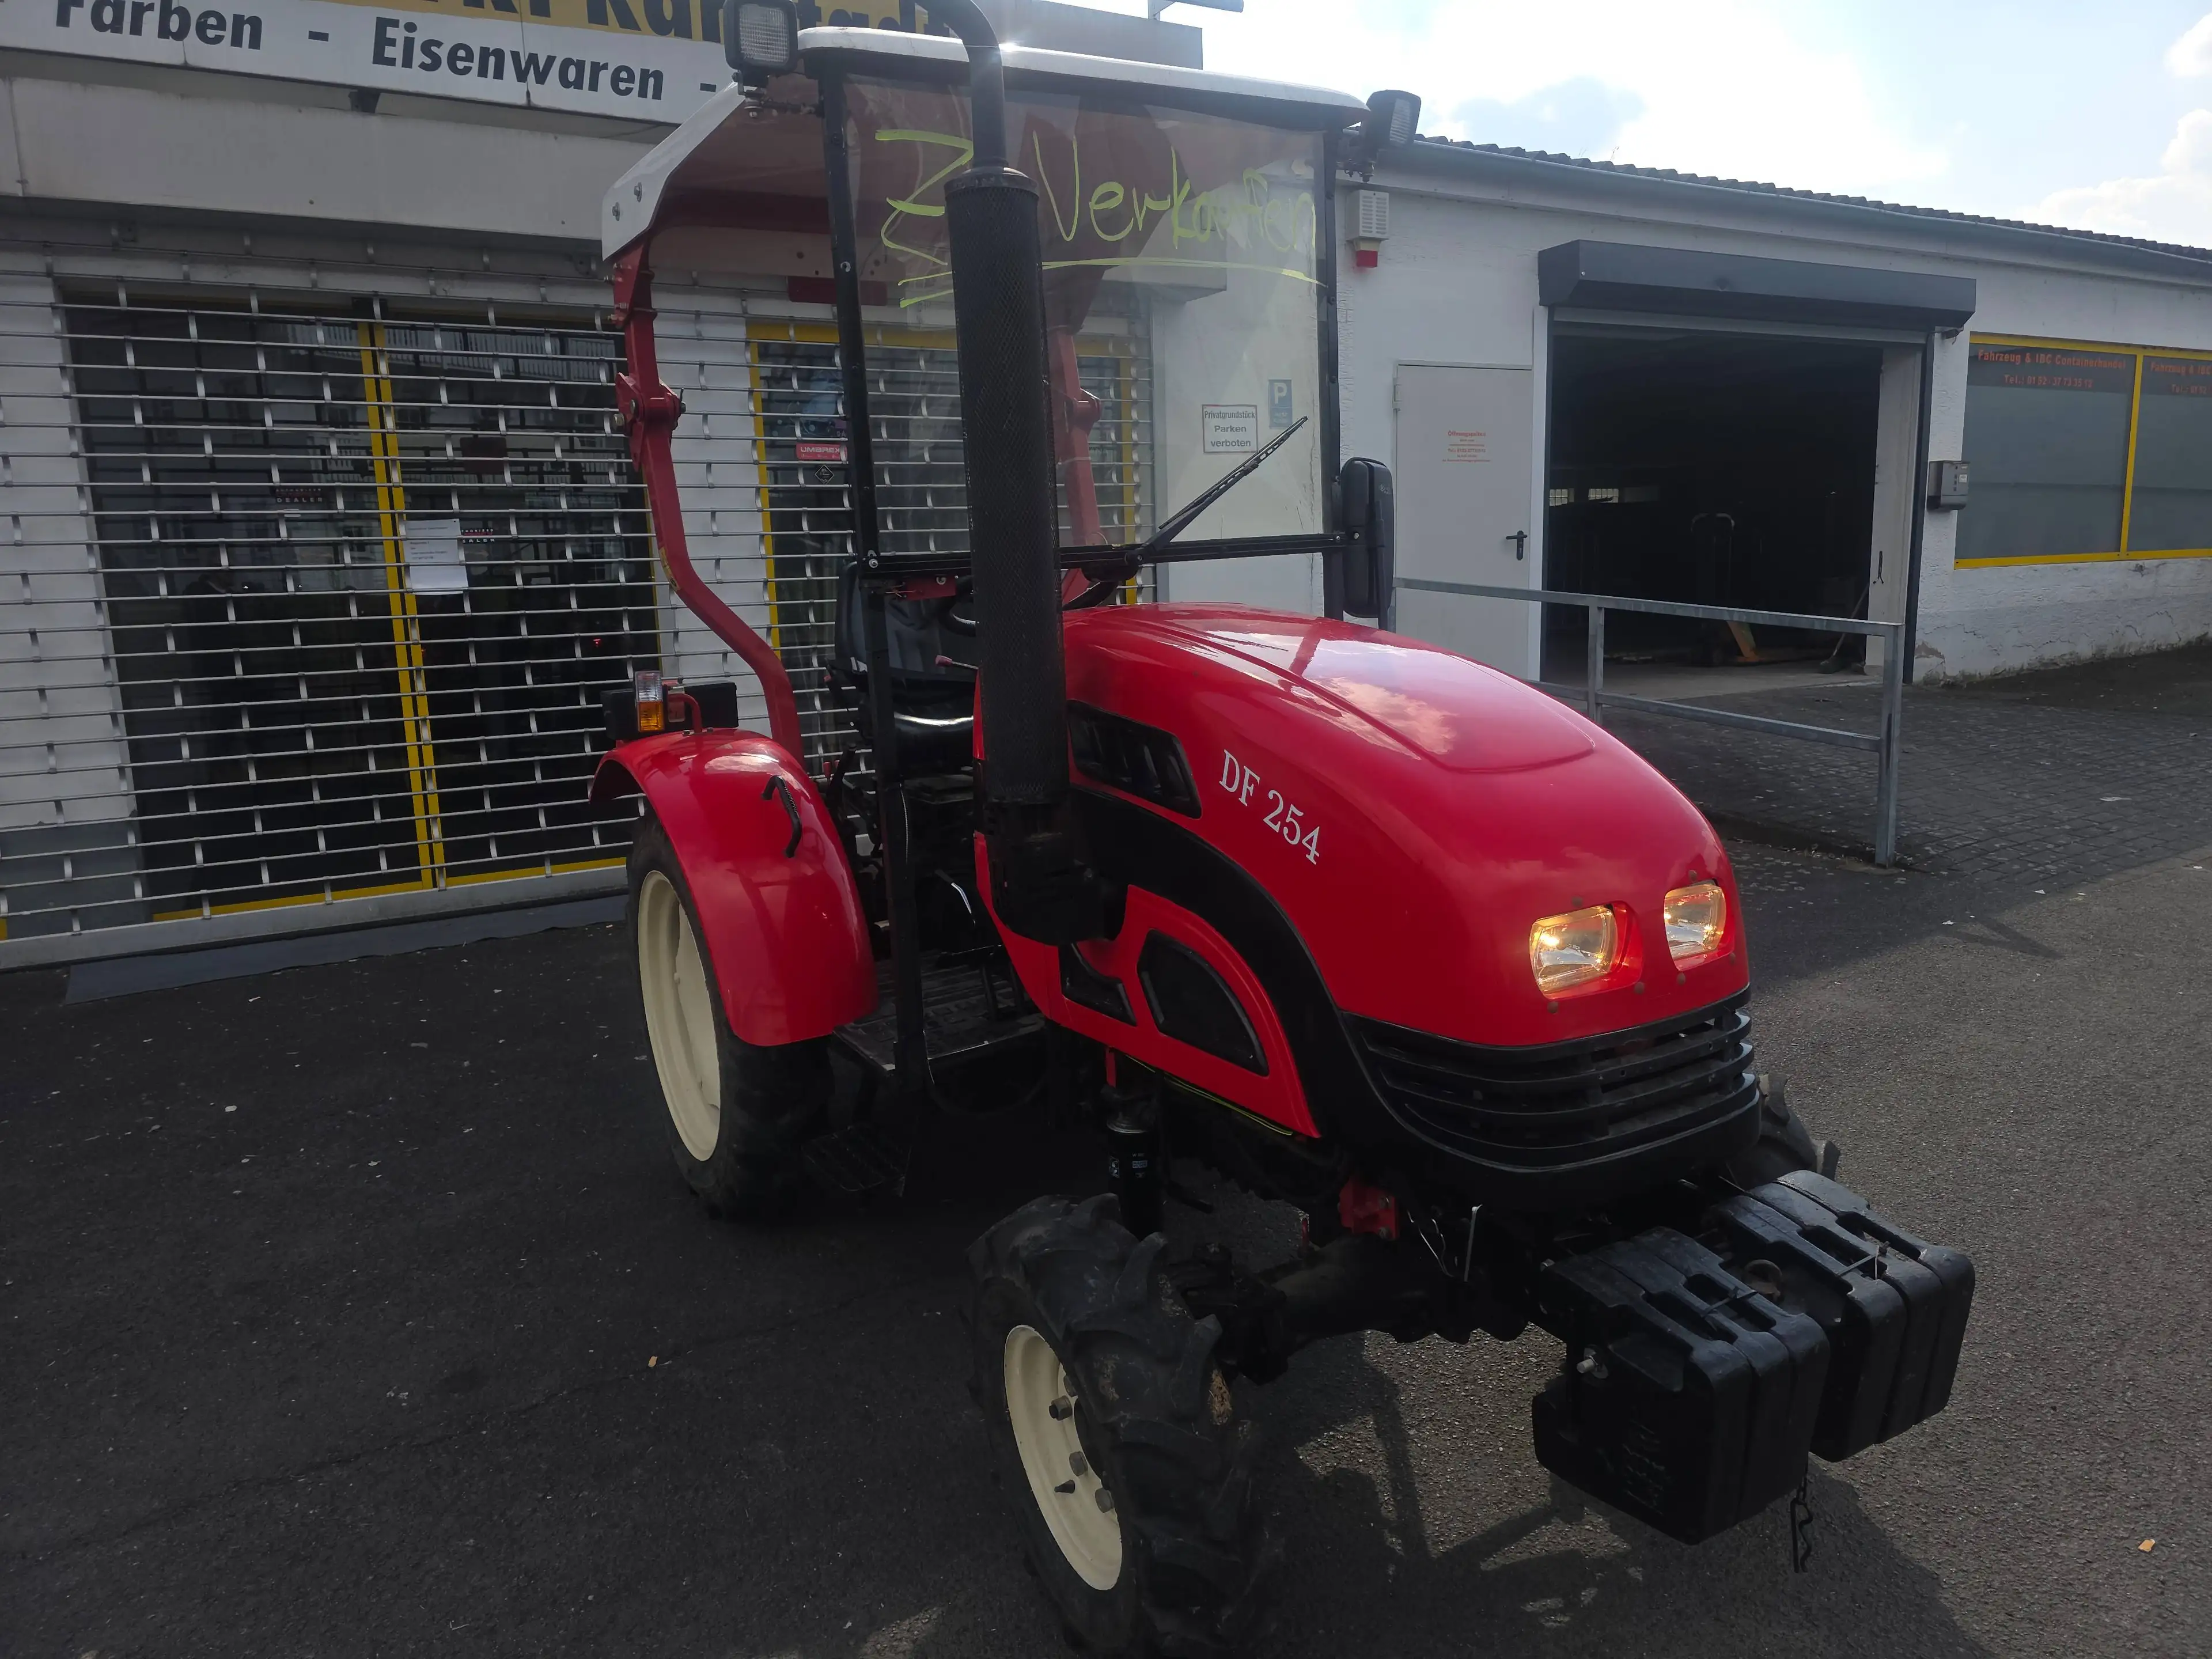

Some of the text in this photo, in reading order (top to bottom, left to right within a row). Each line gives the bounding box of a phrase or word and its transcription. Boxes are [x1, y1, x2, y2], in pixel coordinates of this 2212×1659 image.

[55, 0, 263, 50] Farben
[372, 16, 664, 101] Eisenwaren
[1978, 349, 2021, 365] Fahrzeug
[1274, 382, 1287, 404] P
[1205, 410, 1255, 419] Privatgrundstück
[1214, 425, 1247, 433] Parken
[1211, 439, 1251, 447] verboten
[1219, 749, 1320, 865] DF 254
